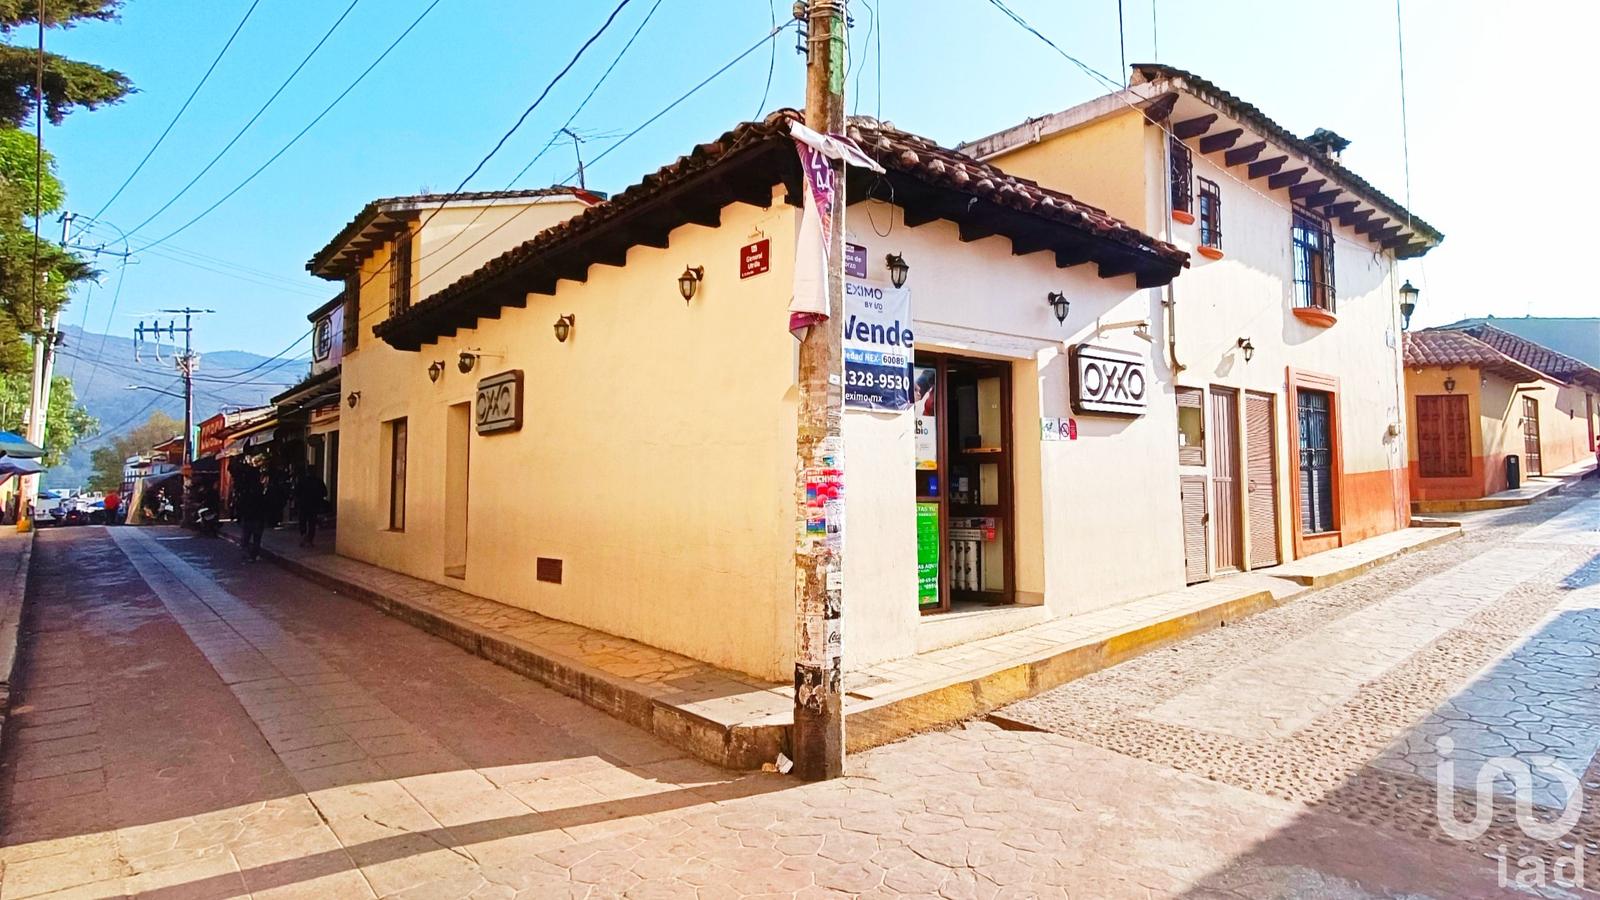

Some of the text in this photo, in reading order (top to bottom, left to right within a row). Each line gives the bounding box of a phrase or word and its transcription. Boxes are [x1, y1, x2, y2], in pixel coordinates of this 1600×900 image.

[864, 301, 873, 309] BY
[882, 355, 905, 366] 60089
[1083, 361, 1146, 402] OXXO
[476, 383, 511, 424] OXXO
